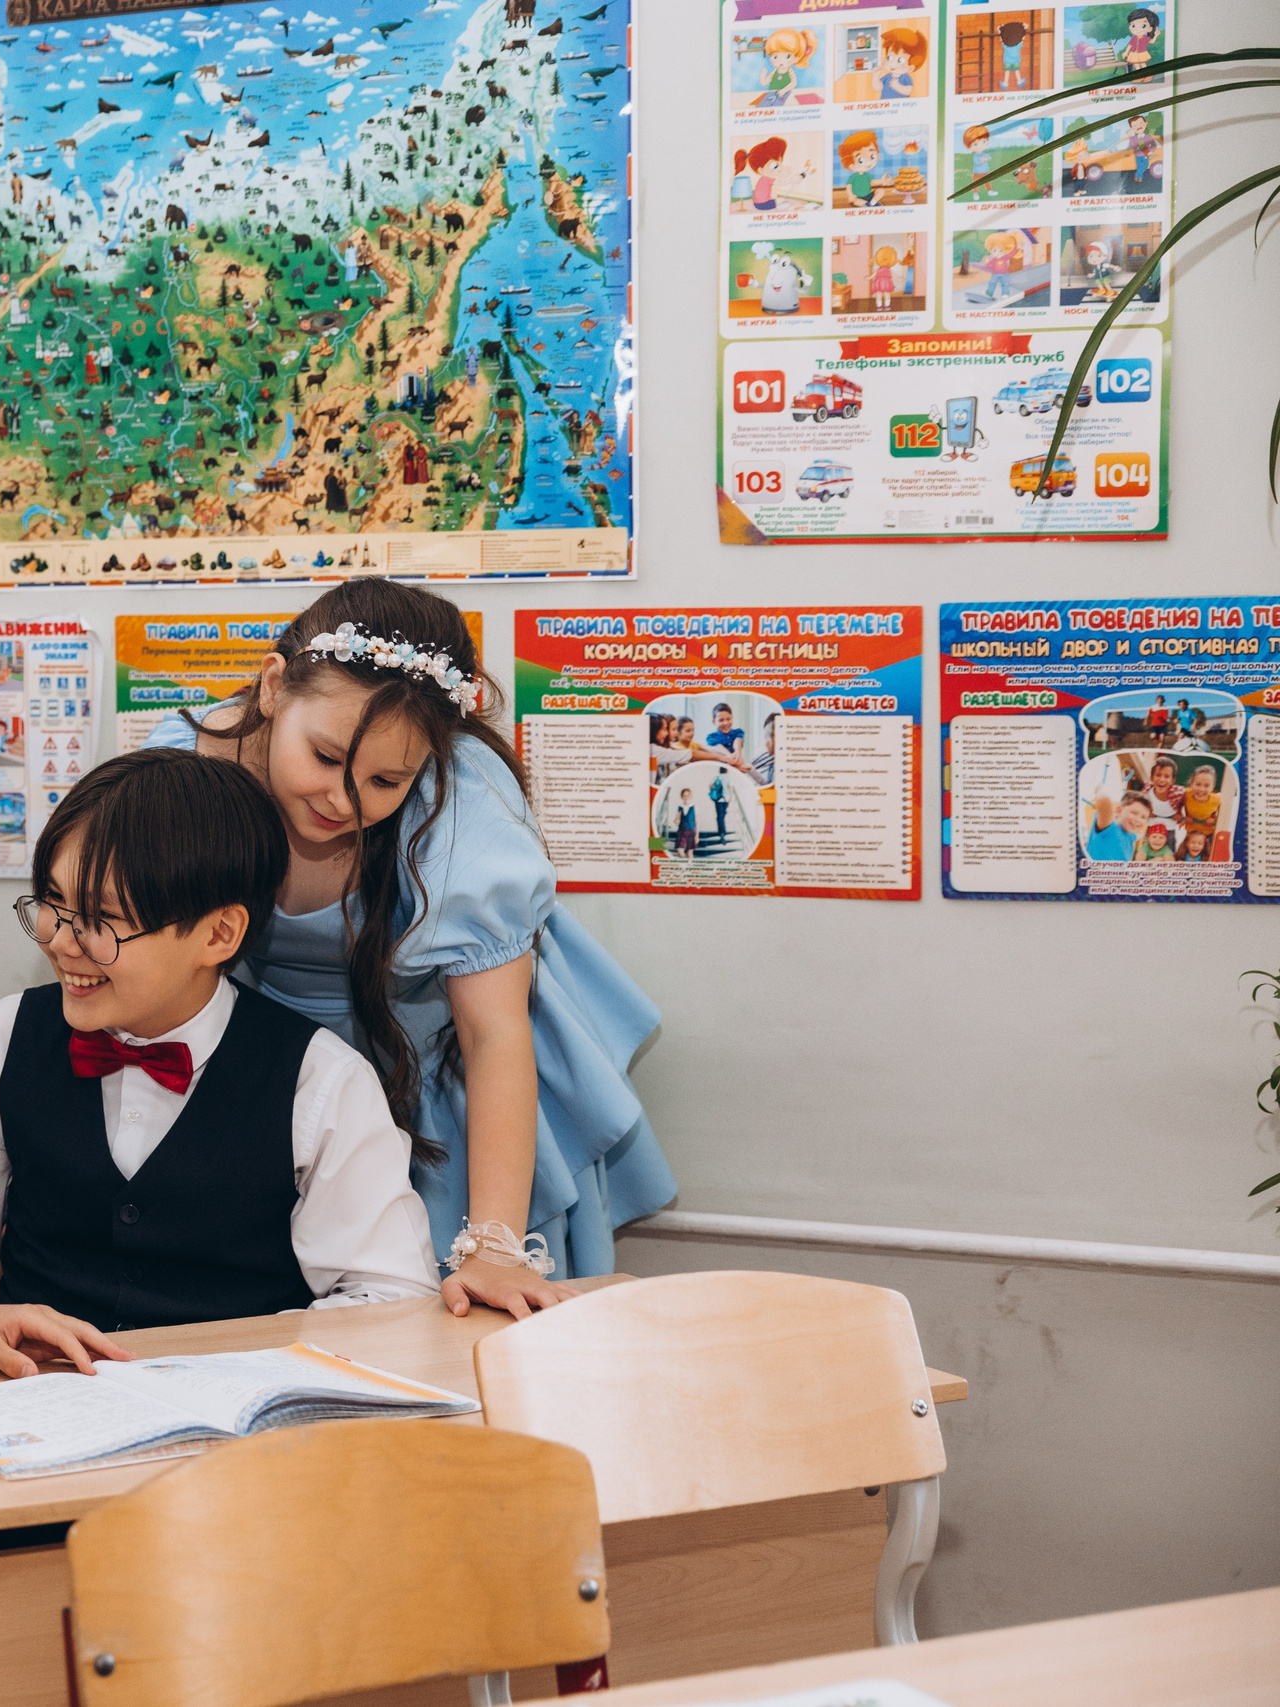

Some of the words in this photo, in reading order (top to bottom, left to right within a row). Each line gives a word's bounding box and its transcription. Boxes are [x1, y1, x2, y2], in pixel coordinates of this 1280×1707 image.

[1103, 87, 1136, 95] ТРОГАЙ
[977, 95, 1005, 103] ИГРАЙ
[857, 102, 890, 110] ПРОБУЙ
[748, 109, 775, 117] ИГРАЙ
[981, 203, 1015, 211] ДРАЗНИ
[1084, 196, 1154, 205] РАЗГОВАРИВАЙ
[851, 314, 896, 322] ОТКРЫВАЙ
[970, 310, 1015, 318] НАСТУПАЙ
[887, 336, 993, 354] Запомни!
[816, 358, 901, 371] Телефоны
[907, 355, 1006, 368] экстренных
[1013, 351, 1065, 365] служб
[1097, 367, 1151, 393] 102
[736, 379, 782, 404] 101
[891, 422, 940, 449] 112
[1097, 462, 1149, 488] 104
[735, 471, 782, 493] 103
[537, 616, 625, 637] ПРАВИЛА
[634, 615, 752, 638] ПОВЕДЕНИЯ
[760, 614, 791, 635] НА
[798, 613, 903, 636] ПЕРЕМЕНЕ
[962, 611, 1060, 632] ПРАВИЛА
[1070, 608, 1199, 631] ПОВЕДЕНИЯ
[1210, 608, 1243, 628] НА
[146, 623, 219, 640] ПРАВИЛА
[583, 642, 687, 662] КОРИДОРЫ
[702, 642, 718, 660] И
[727, 641, 839, 661] ЛЕСТНИЦЫ
[951, 637, 1050, 658] ШКОЛЬНЫЙ
[1061, 638, 1109, 659] ДВОР
[1116, 638, 1130, 656] И
[1138, 637, 1260, 656] СПОРТИВНАЯ
[562, 666, 600, 675] Многие
[604, 667, 652, 677] учащиеся
[655, 666, 699, 675] считают,
[702, 667, 719, 675] что
[738, 667, 790, 676] перемене
[831, 667, 868, 676] делать
[946, 664, 969, 673] Если
[990, 665, 1042, 675] перемене
[1079, 664, 1120, 672] хочется
[1124, 661, 1172, 671] побегать
[637, 677, 671, 688] бегать,
[675, 679, 719, 689] прыгать,
[723, 677, 785, 688] баловаться,
[788, 679, 833, 689] кричать,
[836, 679, 881, 690] шуметь.
[1007, 677, 1028, 685] или
[1031, 676, 1087, 684] школьный
[1089, 677, 1119, 687] двор,
[1122, 676, 1142, 684] там
[1146, 675, 1159, 683] ты
[1162, 675, 1205, 685] никому
[1207, 675, 1222, 683] не
[1224, 673, 1267, 685] будешь
[131, 688, 206, 700] РАЗРЕШАЕТСЯ
[963, 693, 1055, 706] РАЗРЕШАЕТСЯ
[543, 695, 627, 710] РАЗРЕШАЕТСЯ
[800, 696, 896, 711] ЗАПРЕЩАЕТСЯ
[1091, 861, 1124, 869] случае
[1143, 879, 1187, 887] обратись
[1120, 887, 1185, 895] медицинский
[1188, 887, 1231, 895] кабинет.
